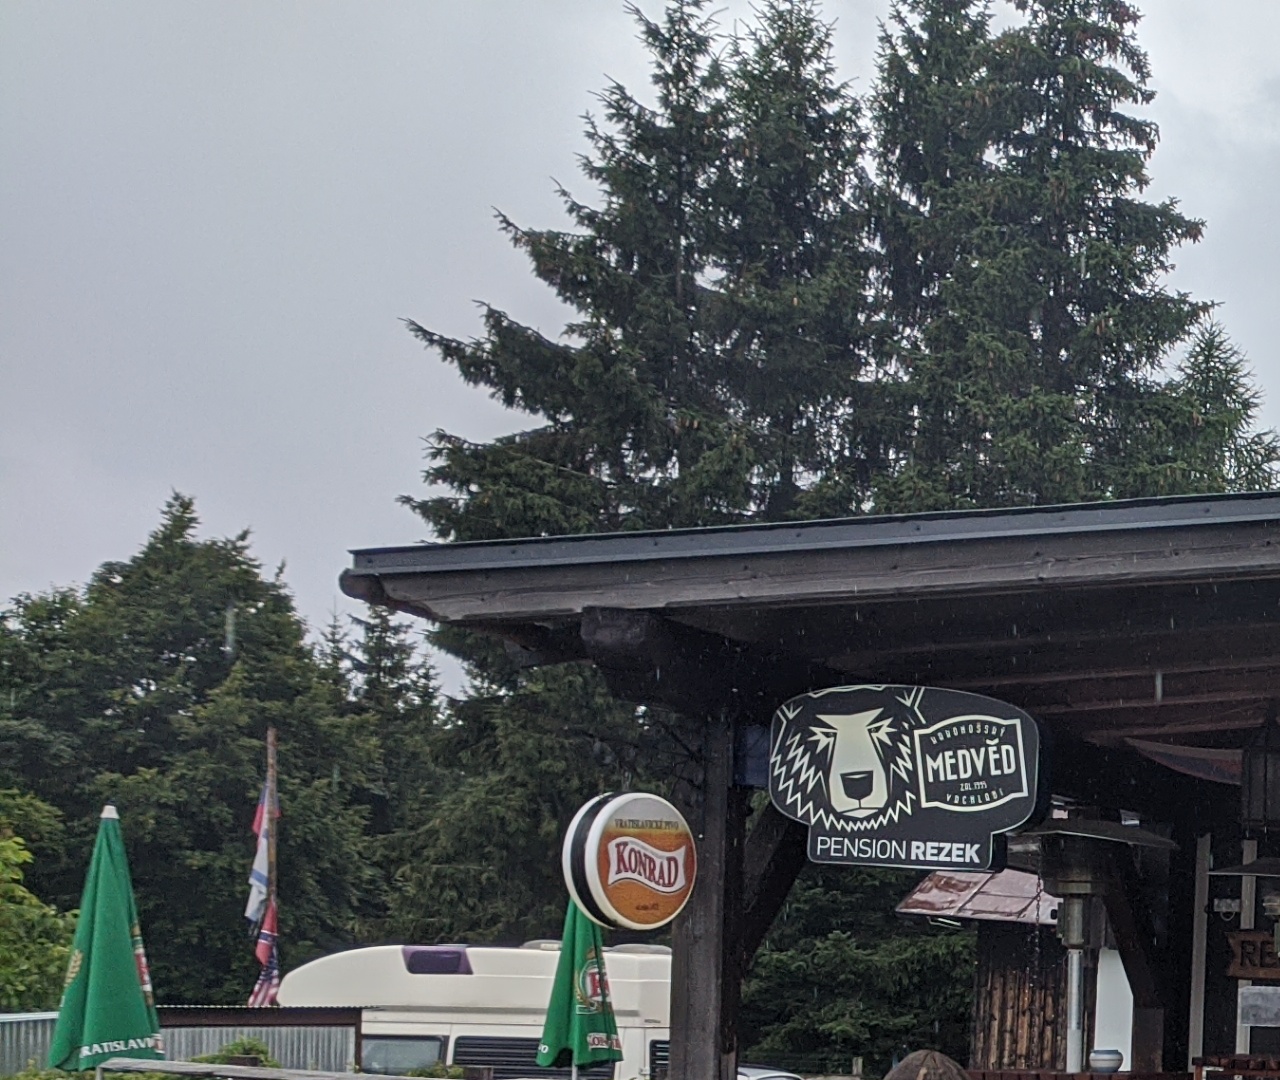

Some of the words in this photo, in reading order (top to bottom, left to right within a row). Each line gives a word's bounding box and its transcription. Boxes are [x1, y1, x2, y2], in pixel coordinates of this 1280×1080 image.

[925, 737, 1017, 783] MEDVĚD
[614, 840, 679, 888] KONRAD
[816, 836, 907, 860] PENSION
[910, 840, 981, 864] REZEK
